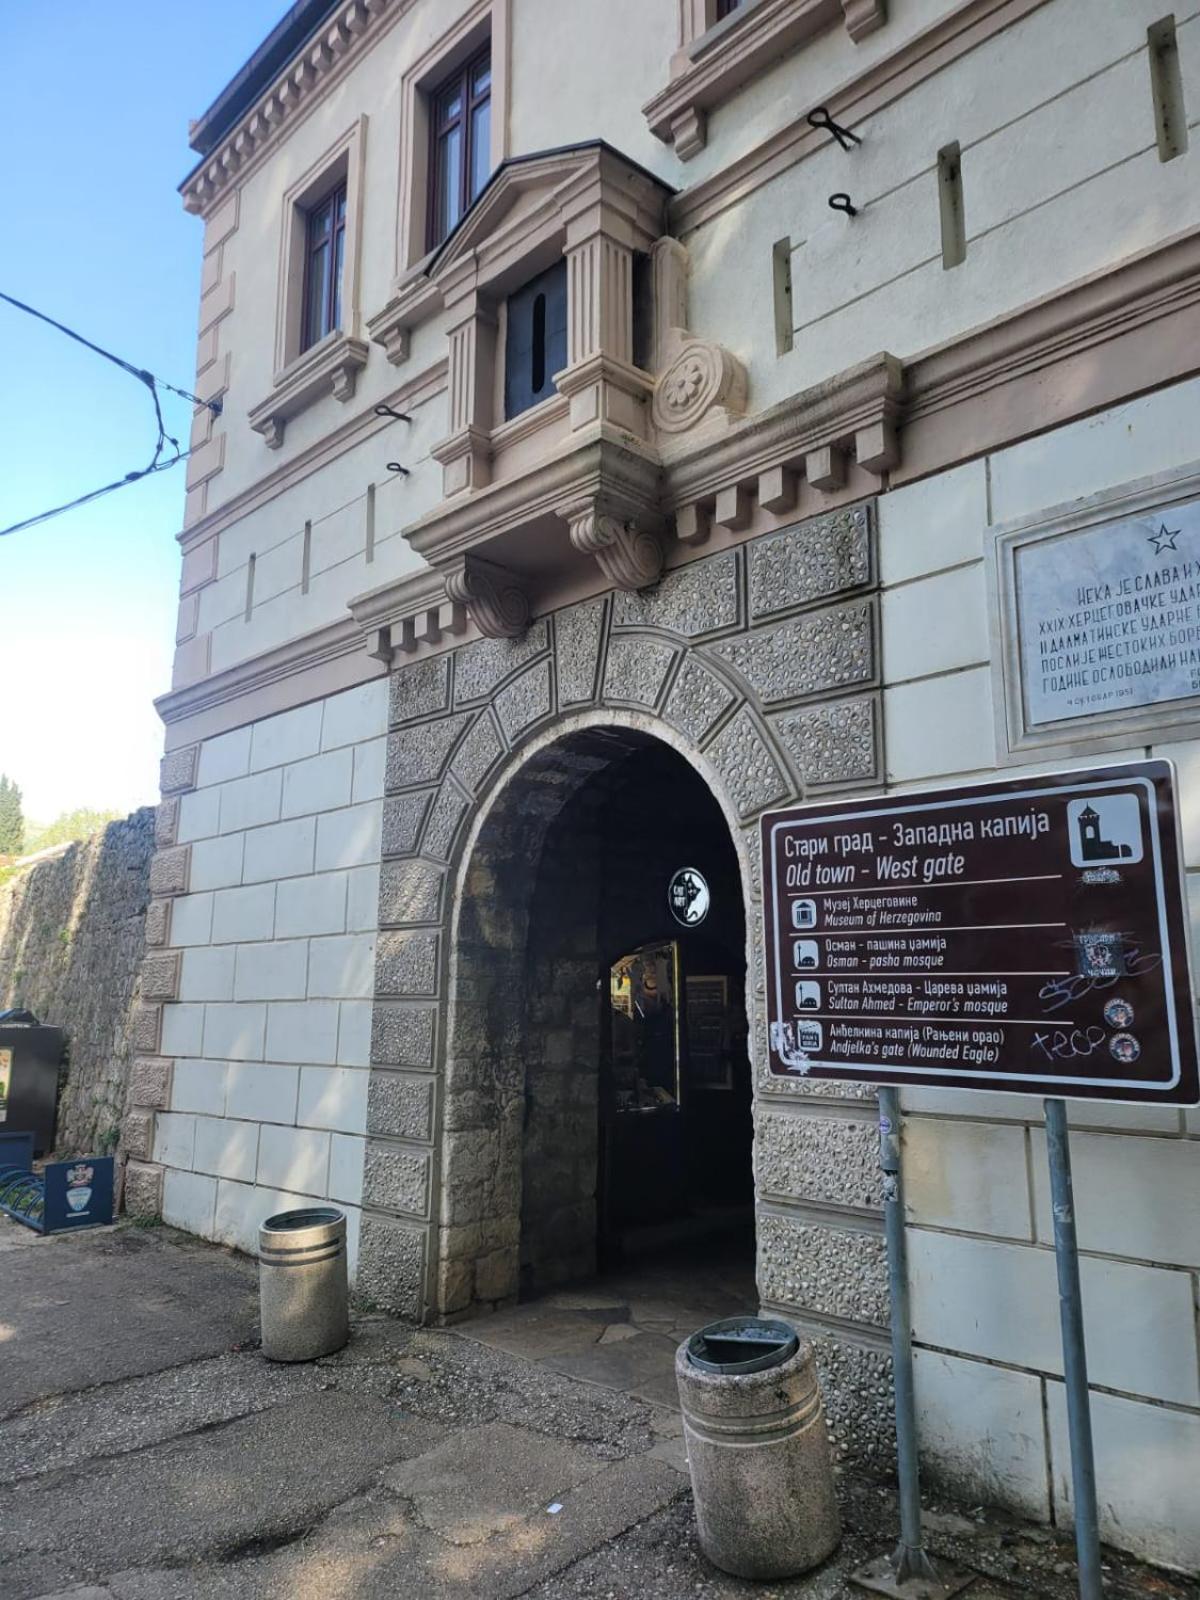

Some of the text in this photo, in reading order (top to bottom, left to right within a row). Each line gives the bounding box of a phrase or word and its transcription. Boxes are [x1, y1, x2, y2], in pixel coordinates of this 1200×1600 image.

[1077, 585, 1111, 606] НЕКА
[1135, 566, 1180, 592] СЛАВА
[1050, 620, 1138, 654] ДАЛМАТИНСКЕ
[1141, 607, 1193, 632] УДАРНЕ
[1041, 649, 1096, 673] ПОСЛИЈЕ
[1043, 670, 1090, 694] ГОДИНЕ
[1092, 653, 1176, 684] ОСЛОБОДИЛИ
[784, 835, 829, 861] Стари
[834, 832, 874, 858] град
[893, 822, 975, 847] Западна
[980, 807, 1051, 841] капија
[786, 861, 813, 888] Old
[815, 864, 856, 885] town
[876, 855, 918, 880] West
[923, 852, 966, 884] gate
[823, 895, 918, 913] Музеј Херцеговине
[824, 909, 942, 927] Museum of Herzegovina
[825, 938, 857, 952] Осман
[866, 938, 907, 951] пашина
[909, 935, 947, 952] џамија
[827, 954, 859, 967] Osman
[869, 953, 900, 970] pasha
[903, 955, 944, 969] mosque
[862, 980, 913, 995] Ахмедова
[924, 980, 964, 997] Царева
[967, 980, 1007, 998] џамија
[828, 997, 860, 1010] Sultan
[861, 997, 896, 1011] Ahmed
[907, 997, 960, 1014] Emperor's
[963, 1000, 1008, 1015] mosque
[829, 1023, 1005, 1045] Анђелкина капија (Рањени орао)
[830, 1039, 879, 1056] Andjelka's
[881, 1043, 905, 1059] gate
[907, 1043, 959, 1061] (Wounded
[962, 1046, 999, 1064] Eagle)
